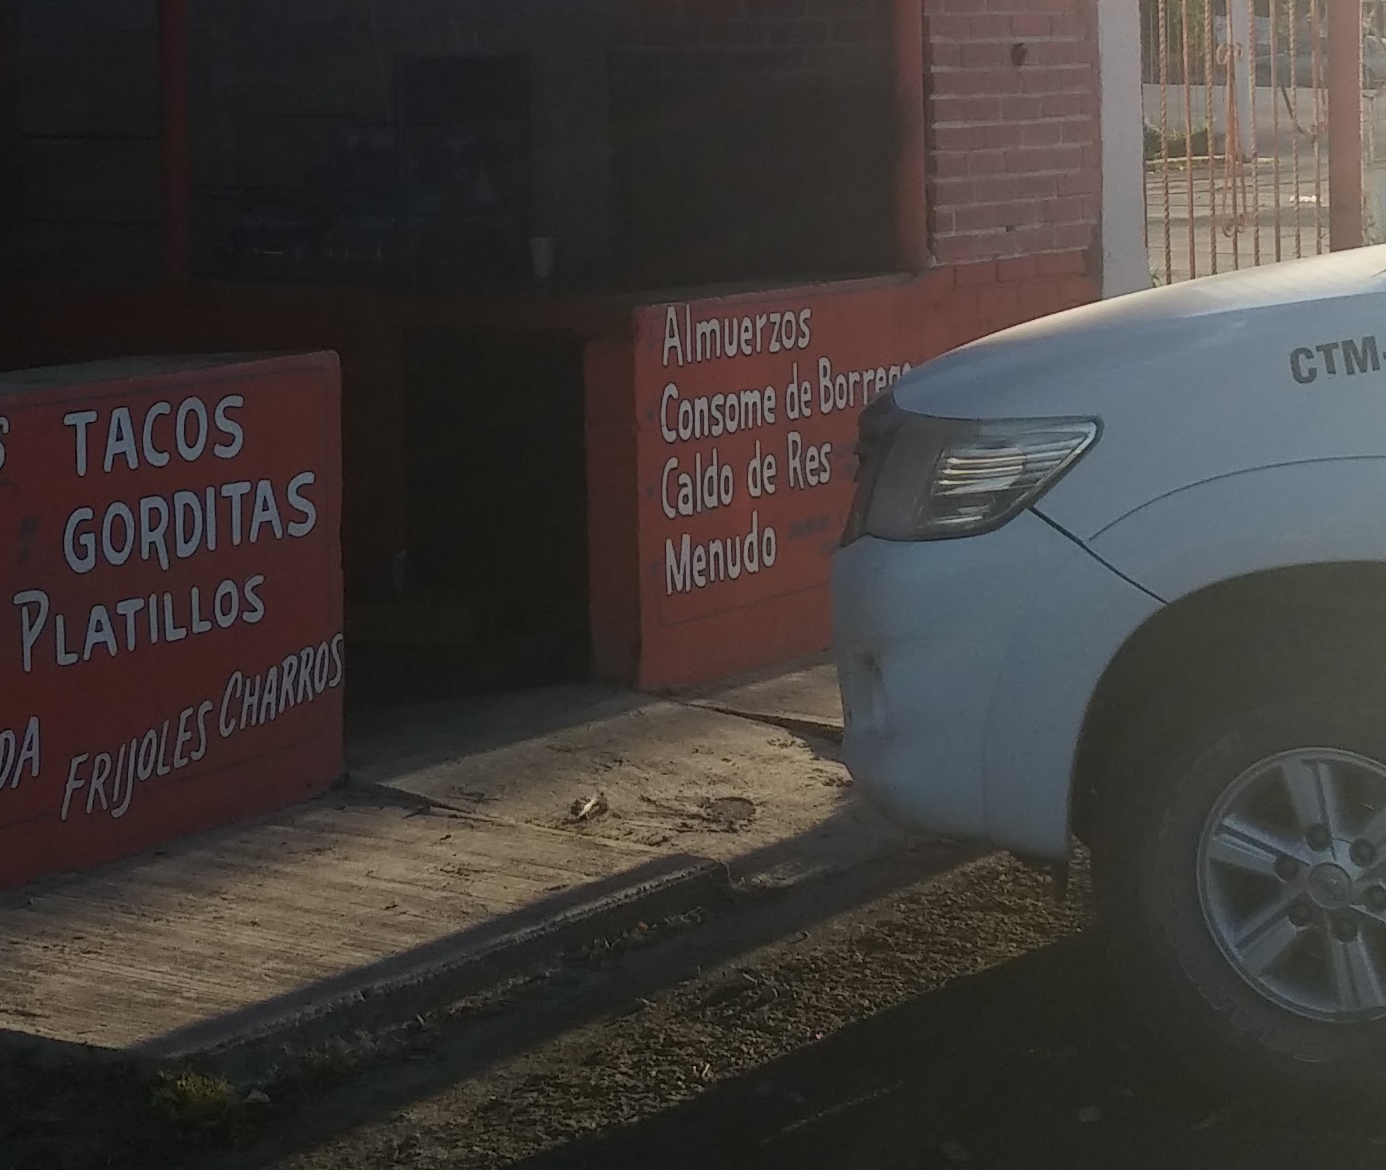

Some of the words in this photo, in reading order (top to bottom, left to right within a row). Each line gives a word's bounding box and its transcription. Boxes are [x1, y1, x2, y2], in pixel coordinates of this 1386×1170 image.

[662, 303, 812, 367] Almuerzos
[63, 394, 245, 477] TACOS
[660, 382, 776, 444] Consome
[785, 361, 812, 420] de
[817, 356, 913, 414] Borre
[661, 447, 734, 520] Caldo
[747, 439, 777, 498] de
[786, 431, 832, 490] Res
[63, 471, 317, 574] GORDITAS
[665, 509, 777, 596] Menudo
[14, 574, 267, 674] PLATILLOS
[60, 699, 213, 821] FRIJOLES
[218, 632, 345, 738] CHARROS
